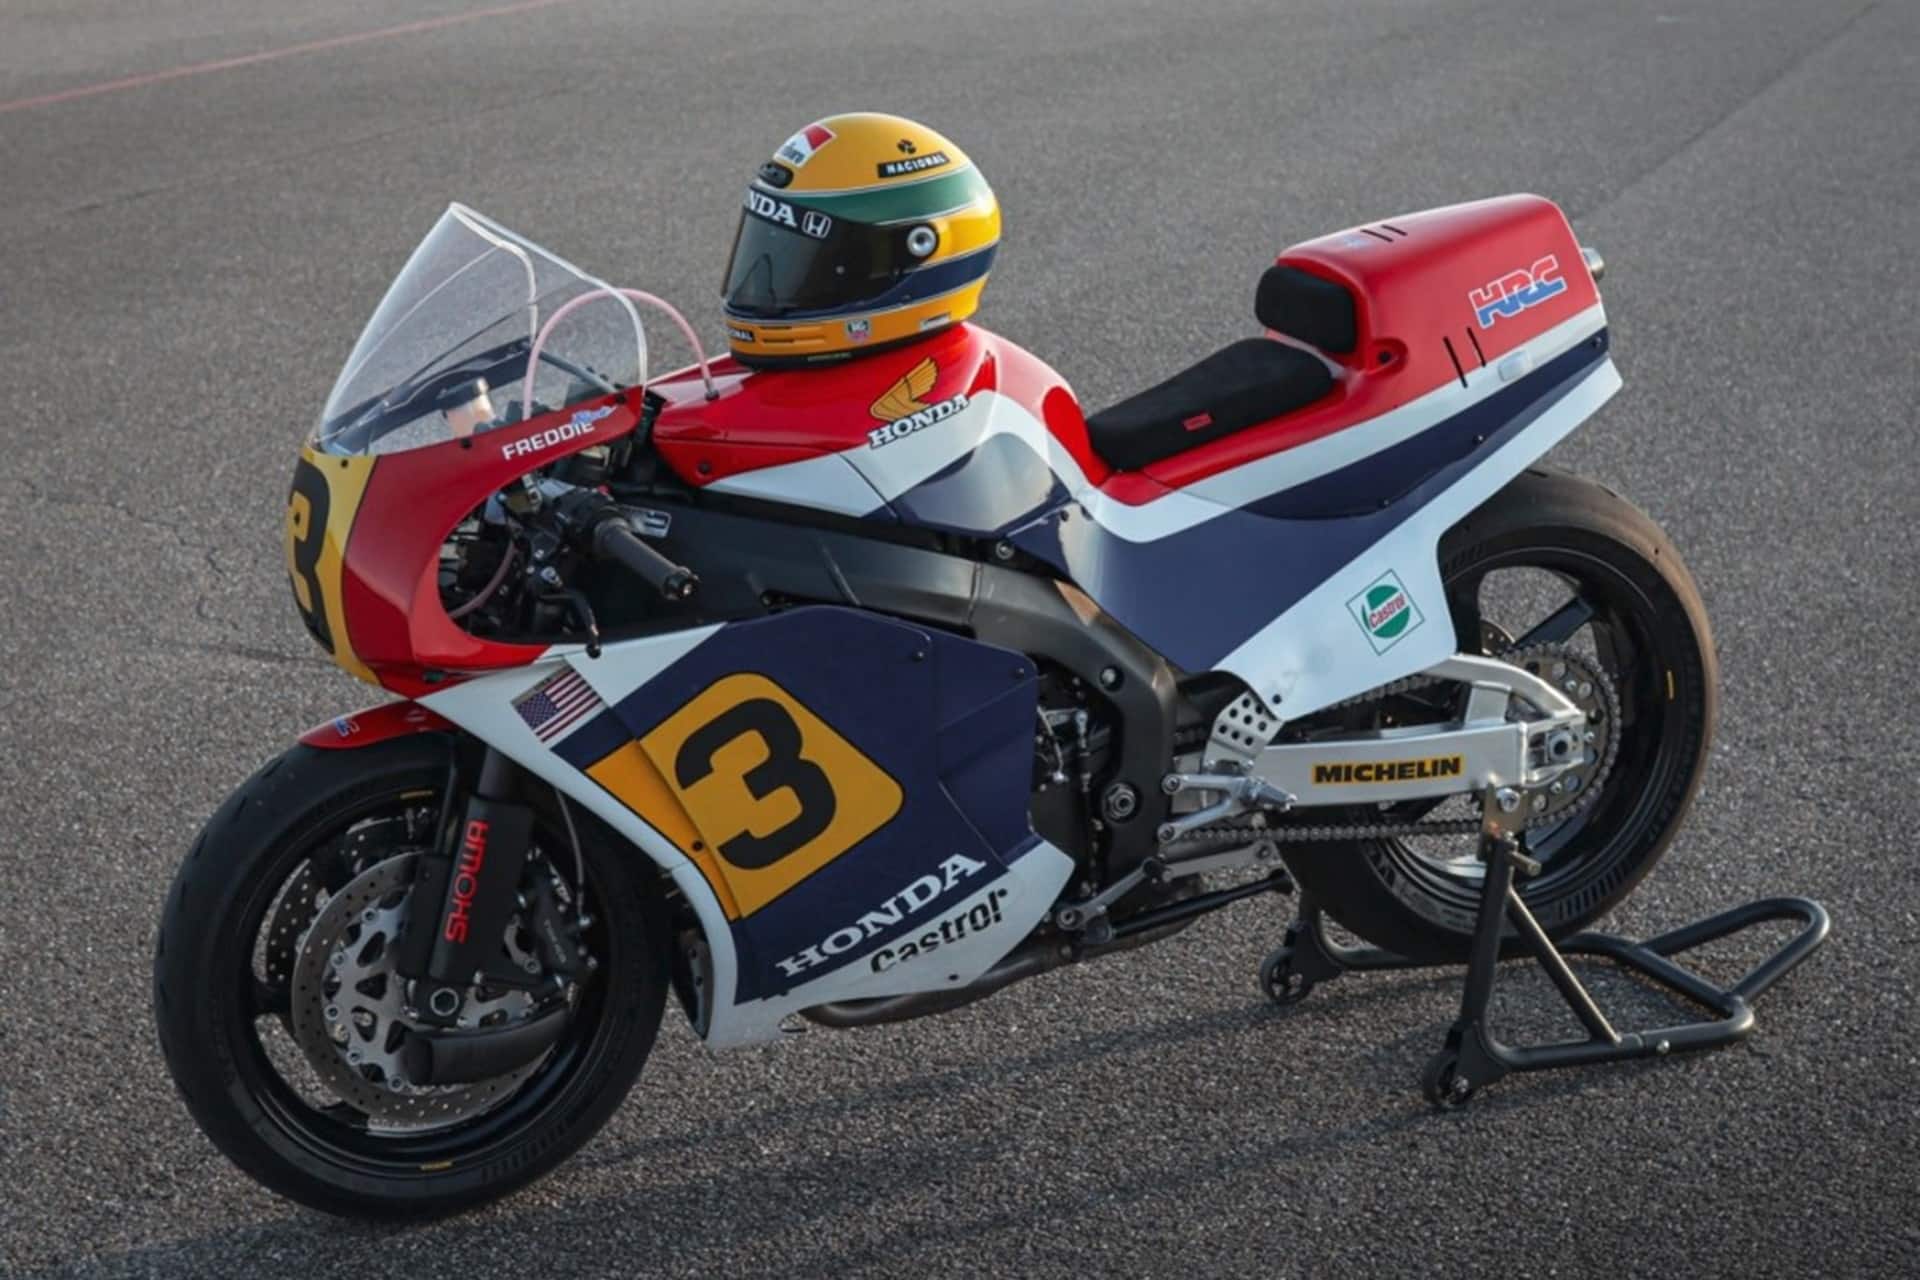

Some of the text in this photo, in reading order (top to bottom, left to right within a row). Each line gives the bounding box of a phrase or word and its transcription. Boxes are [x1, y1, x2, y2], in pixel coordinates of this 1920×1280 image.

[502, 422, 595, 460] FREDDIE
[867, 391, 970, 449] HONDA
[675, 697, 837, 871] 3
[1314, 757, 1461, 783] MICHELIN
[444, 819, 488, 943] SHOWA
[775, 853, 987, 977] HONDA
